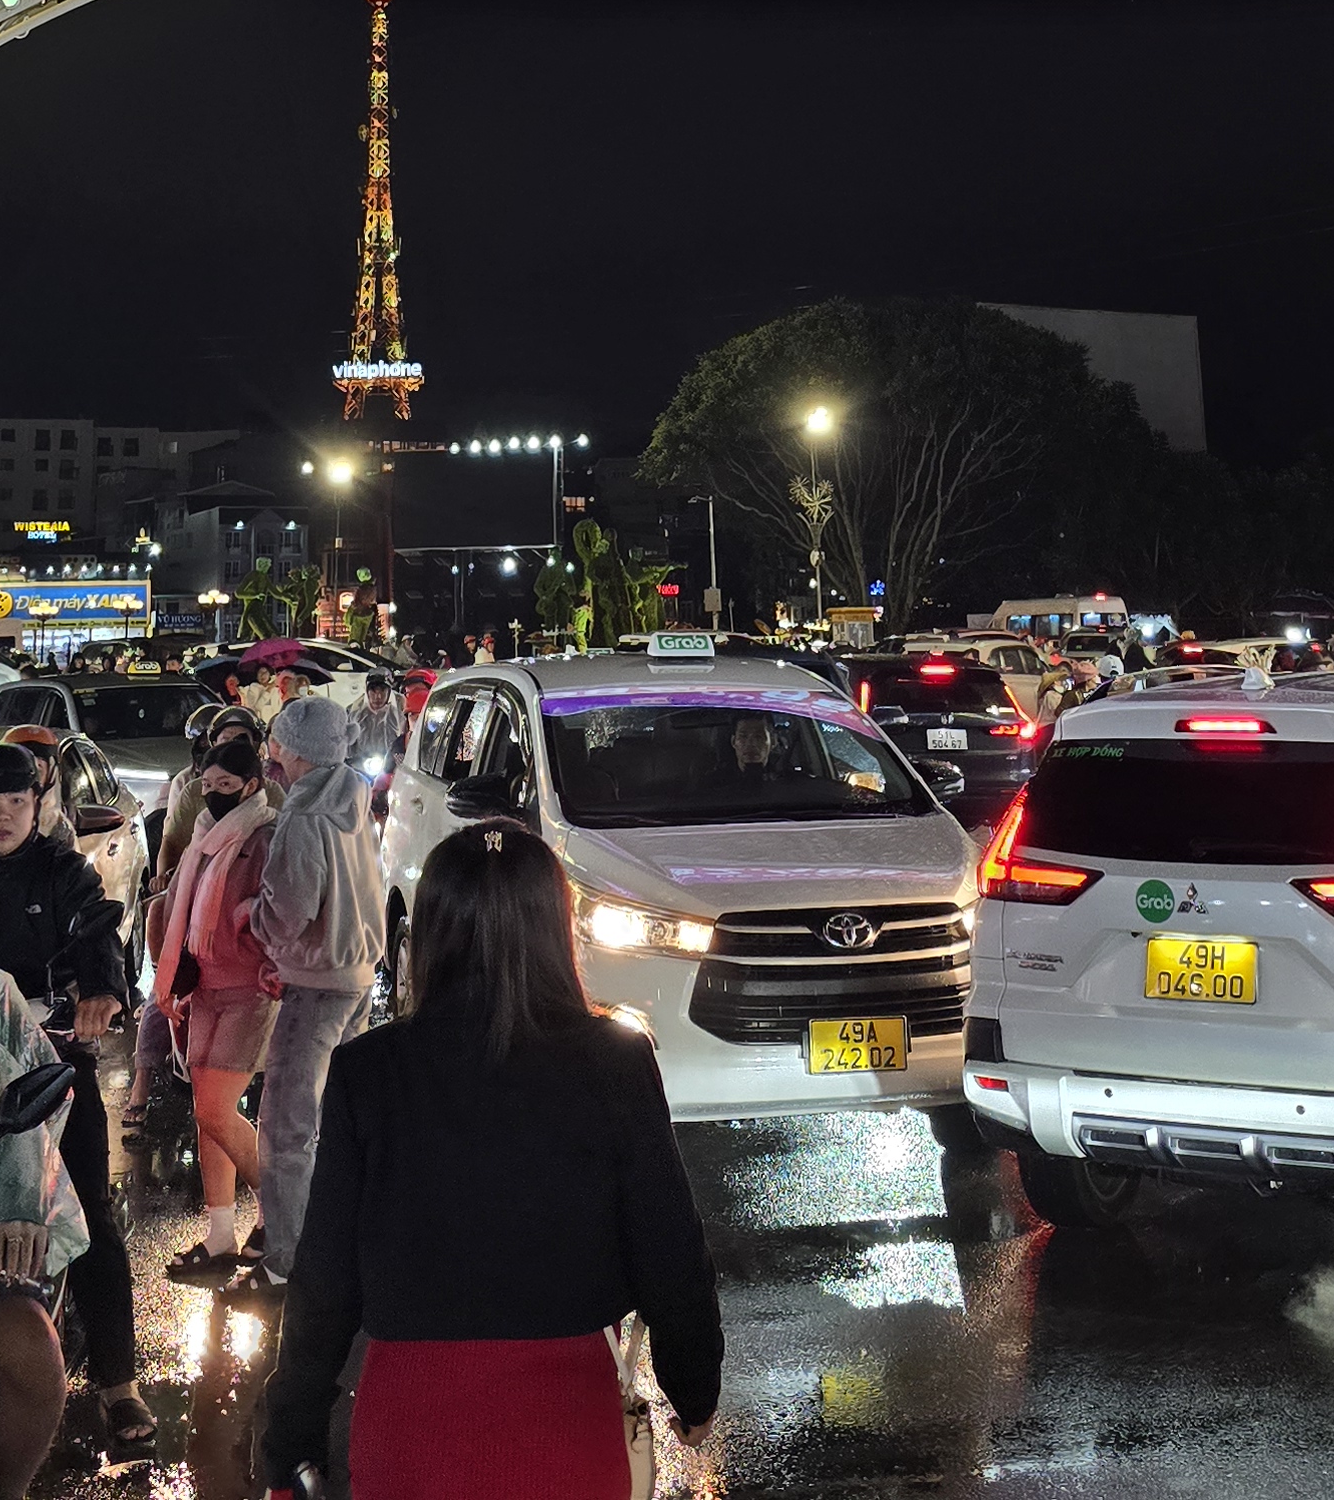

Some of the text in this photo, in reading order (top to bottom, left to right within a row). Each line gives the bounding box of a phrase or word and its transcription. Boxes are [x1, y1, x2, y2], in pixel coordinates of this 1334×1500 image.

[331, 359, 423, 379] vinaphone
[53, 593, 87, 612] máy
[661, 635, 706, 649] Grab
[135, 660, 158, 670] Grab
[937, 730, 956, 740] 51L
[1136, 893, 1175, 911] Grab
[1178, 944, 1226, 971] 49H
[838, 1021, 879, 1044] 49A
[822, 1047, 897, 1071] 242.02
